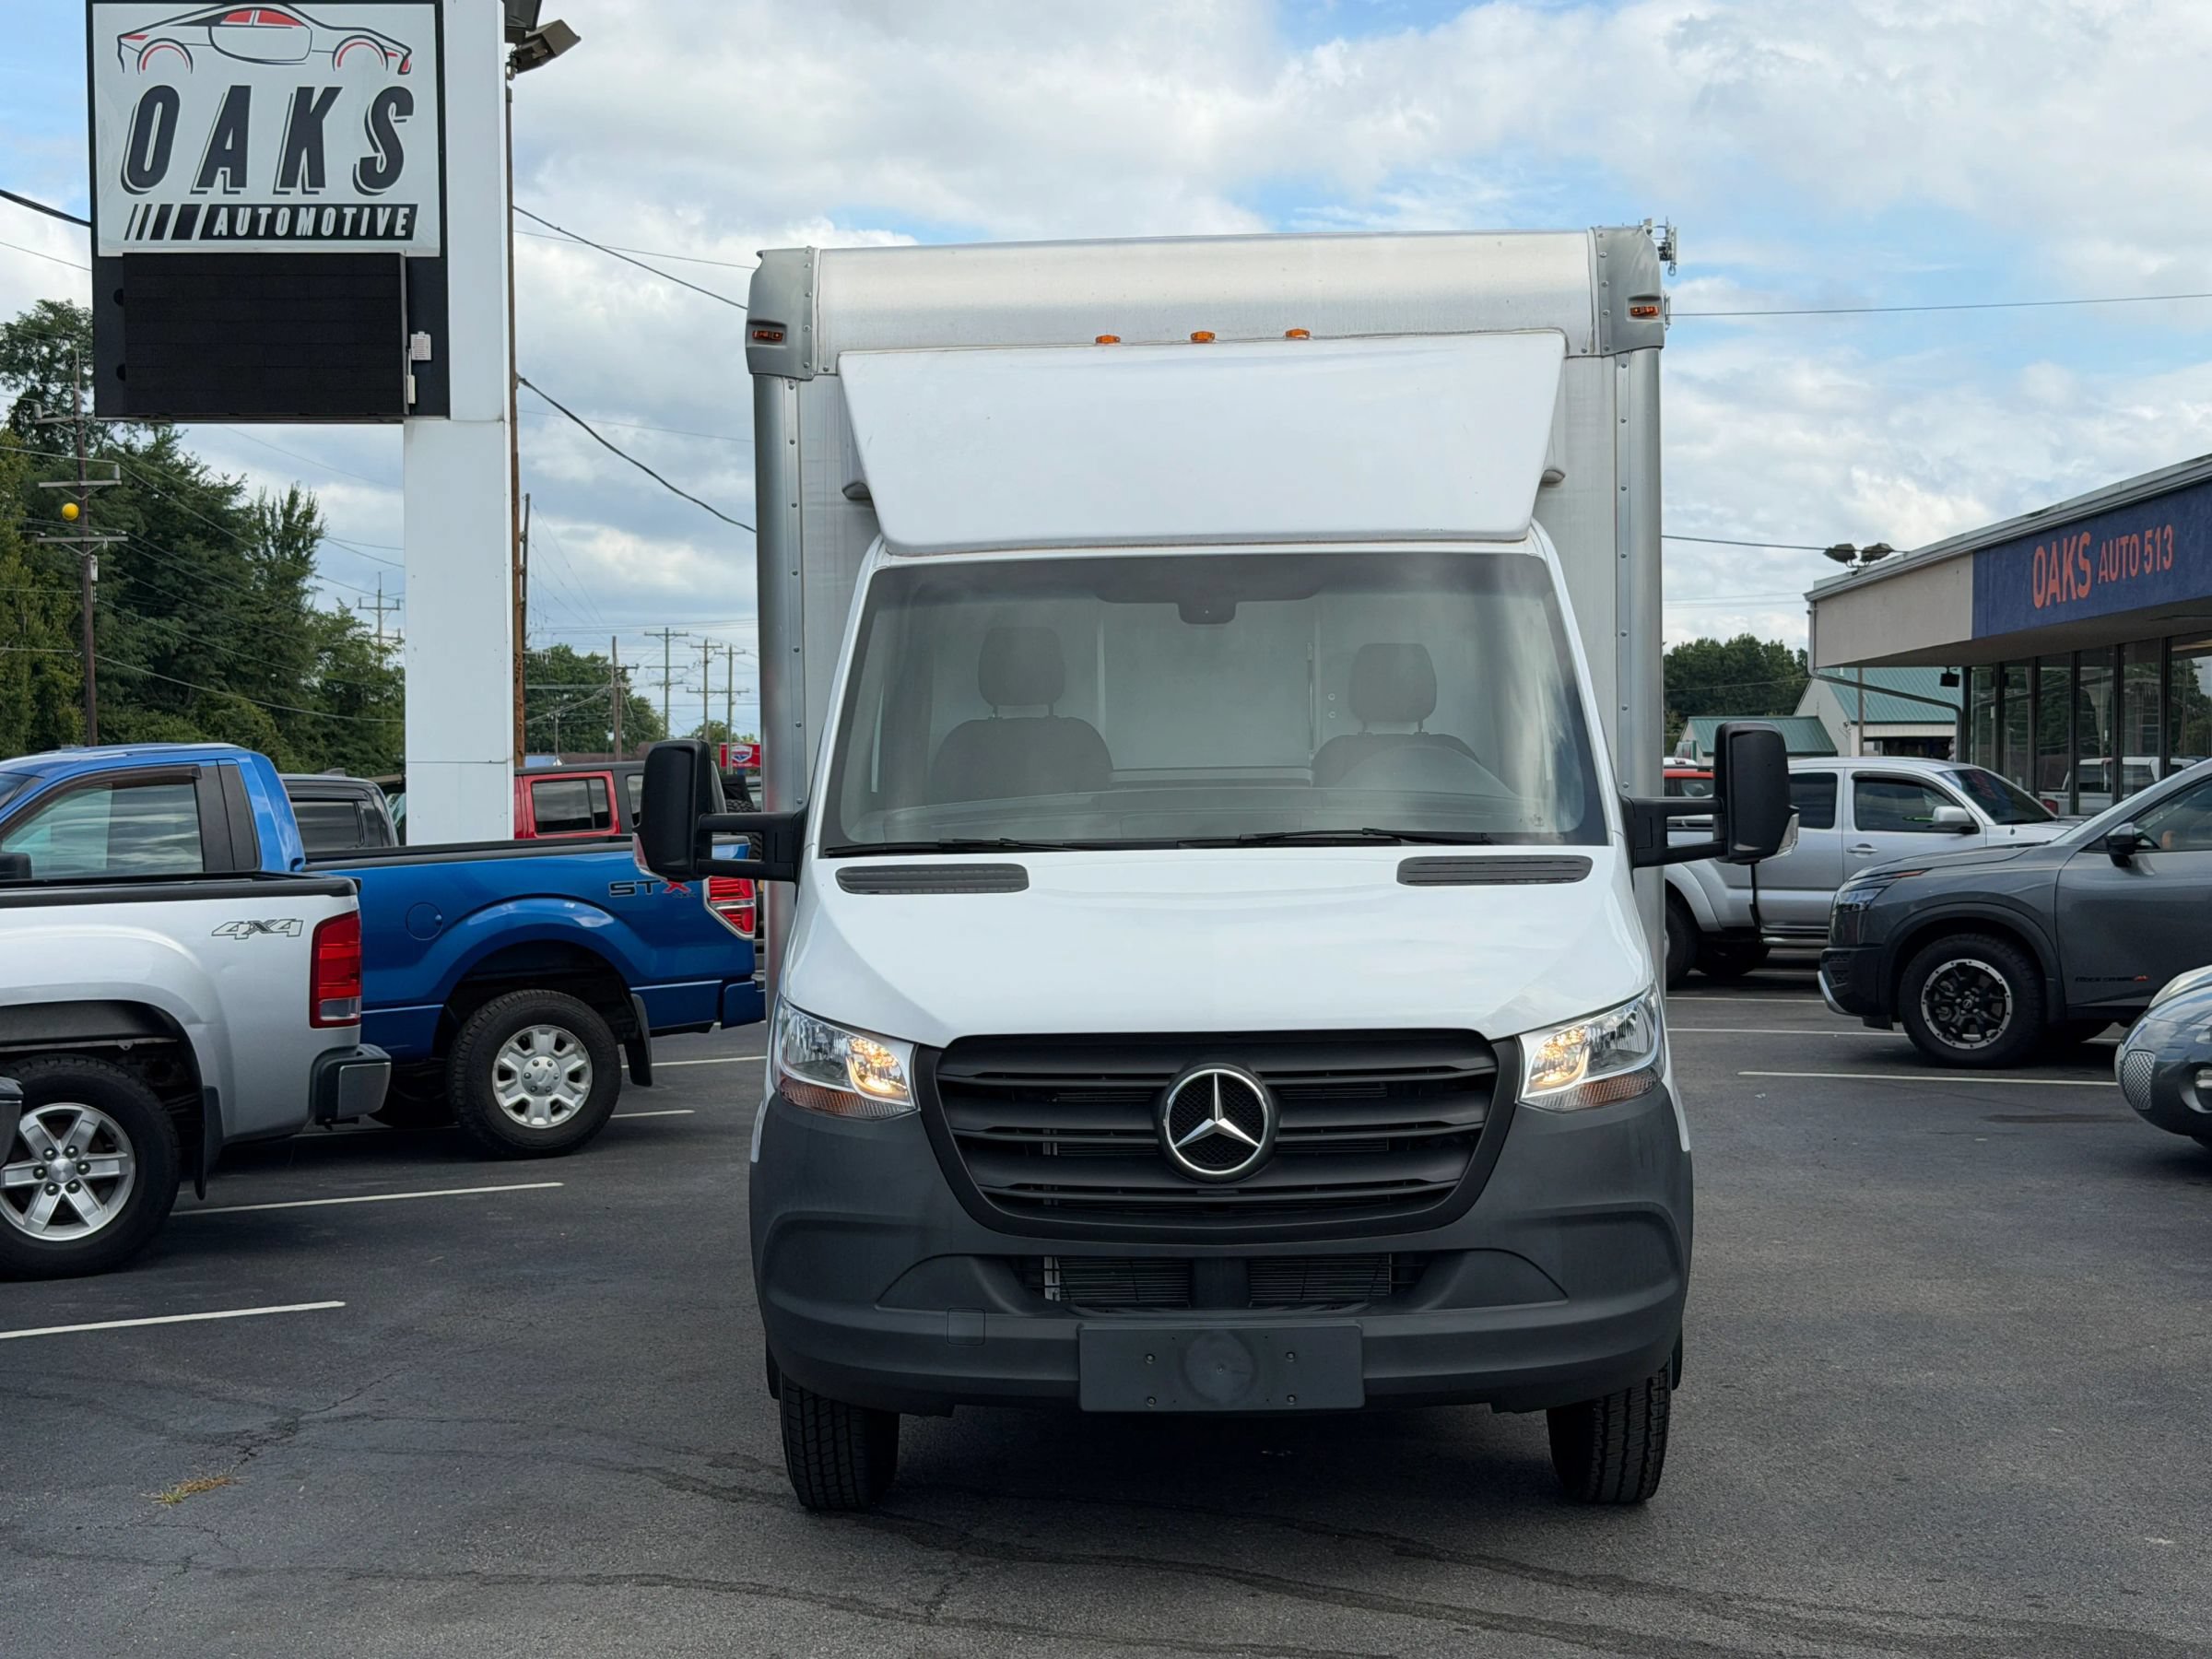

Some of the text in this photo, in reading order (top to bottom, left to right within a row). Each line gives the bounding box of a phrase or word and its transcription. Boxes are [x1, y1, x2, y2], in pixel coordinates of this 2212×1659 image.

[121, 85, 414, 195] OAKS
[212, 207, 411, 237] AUTOMOTIVE
[2033, 524, 2173, 608] OAKS AUTO 513
[609, 879, 691, 897] STX
